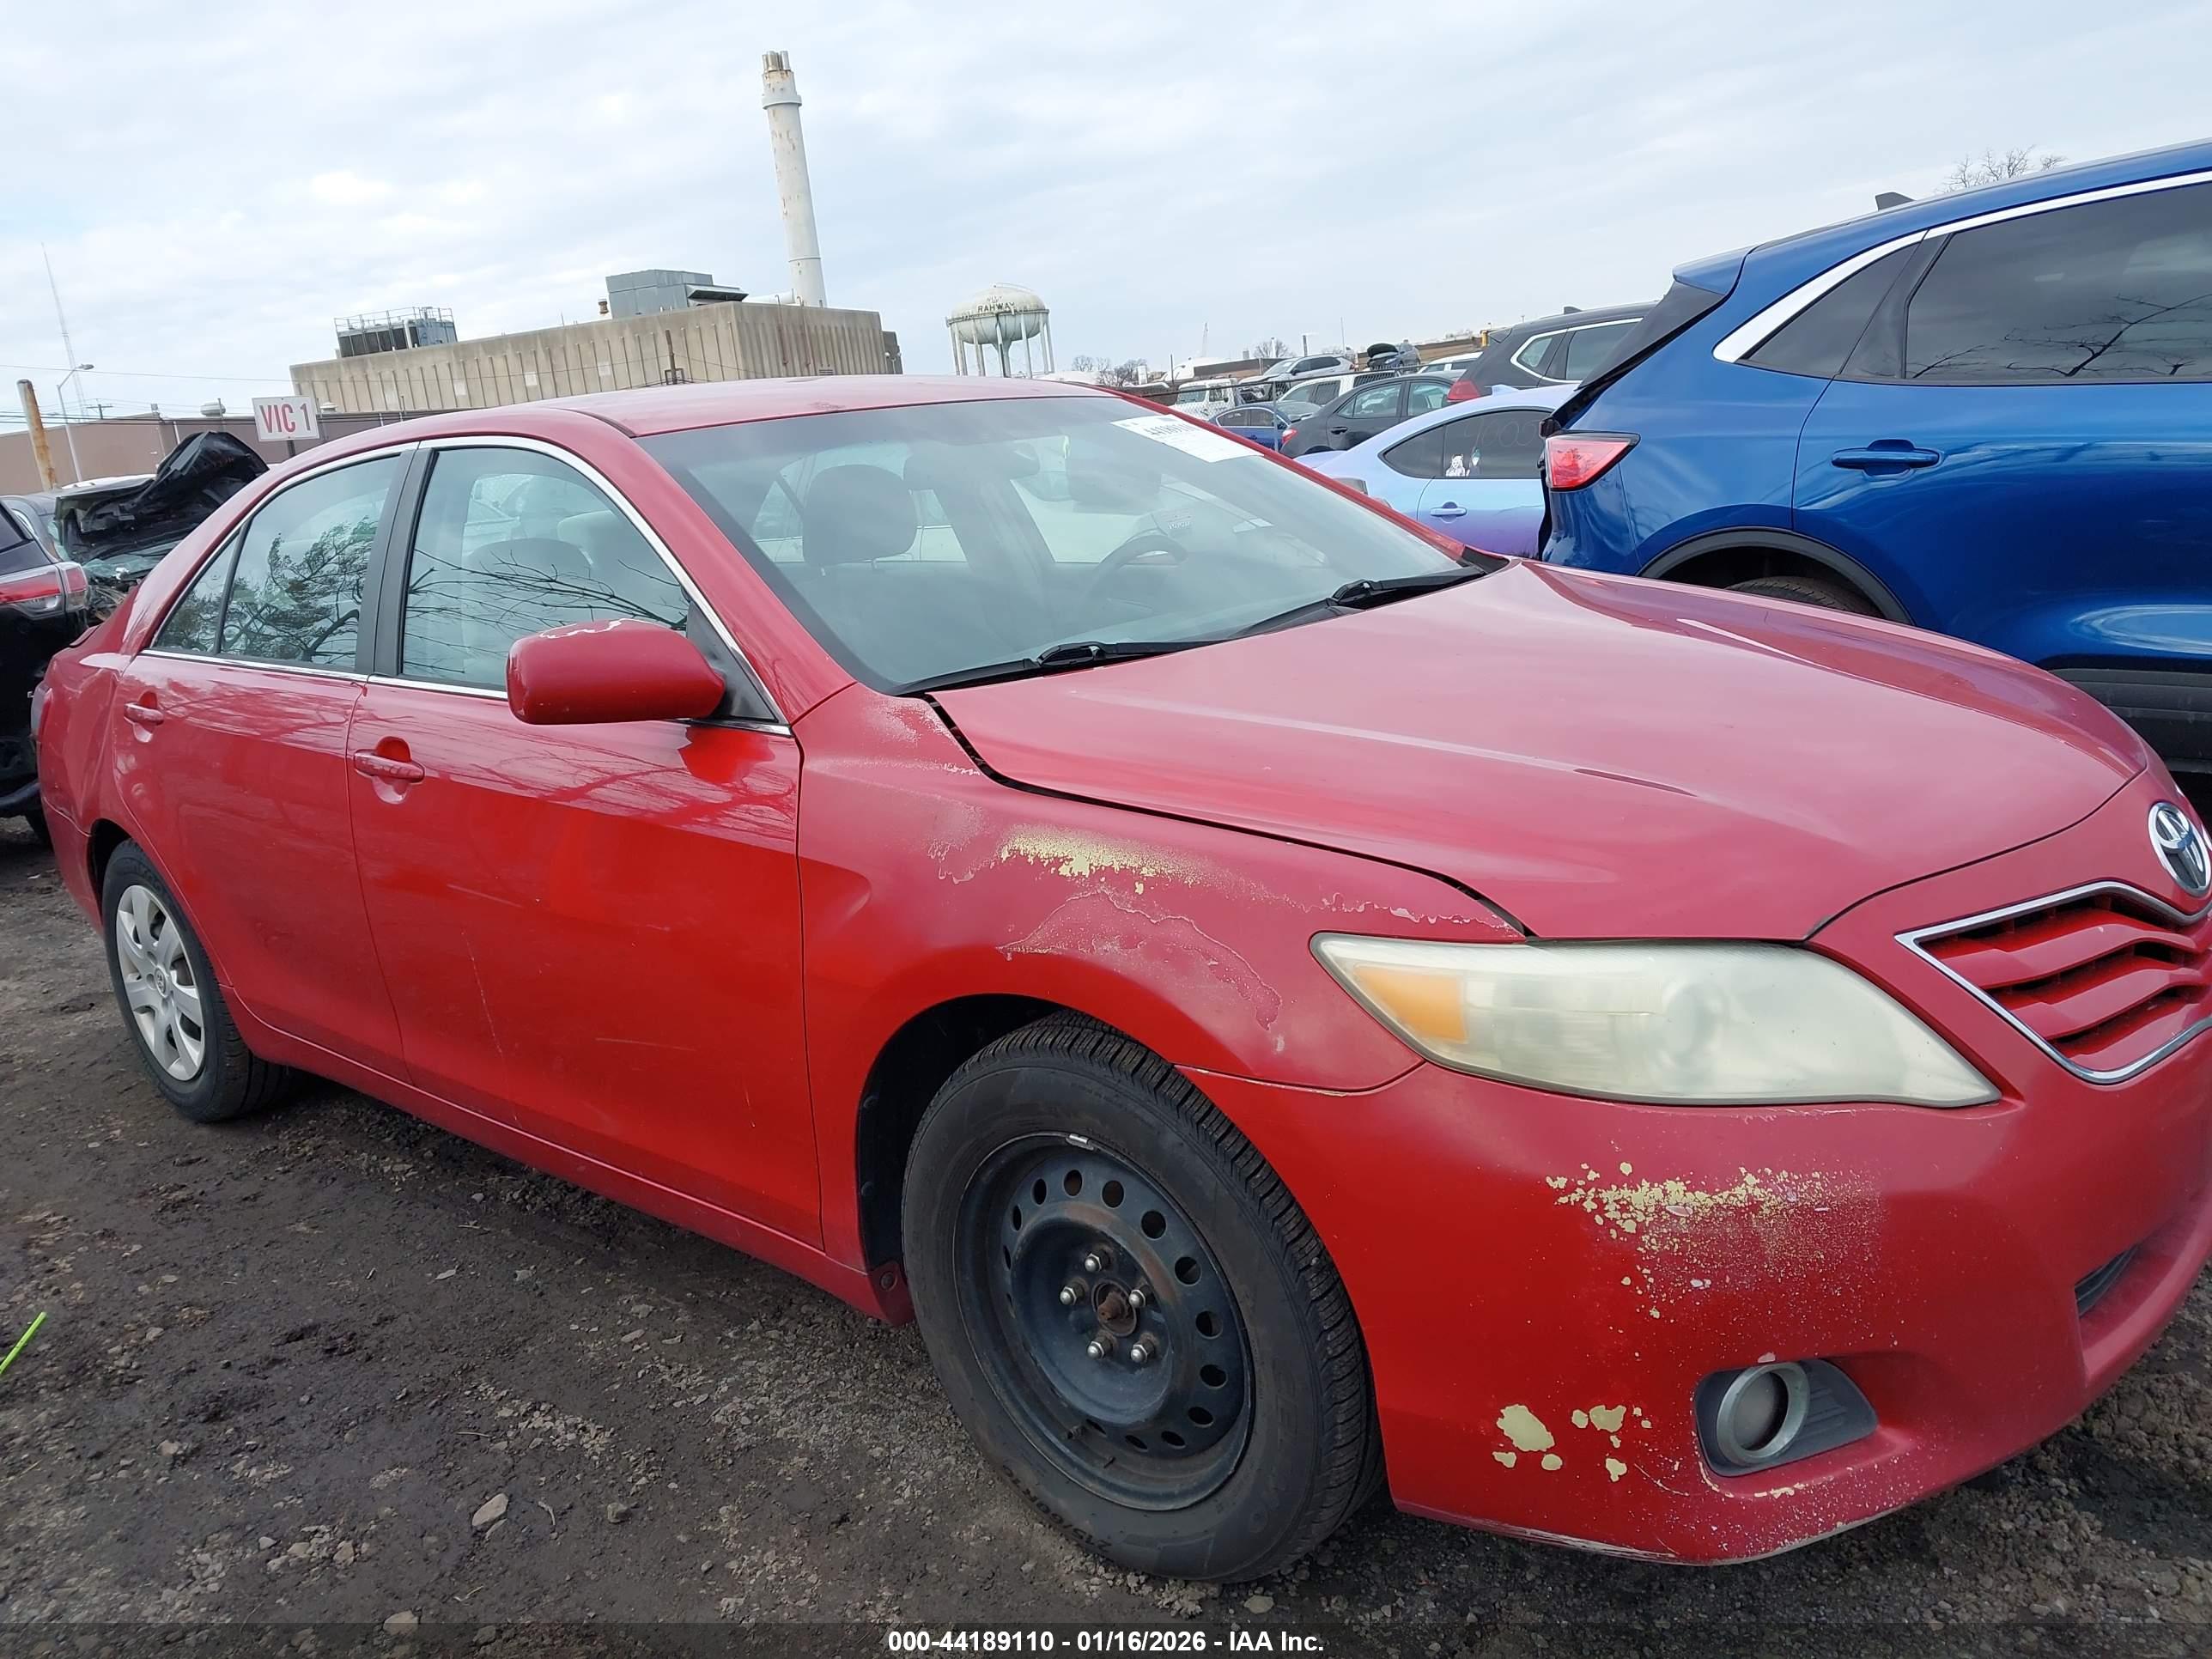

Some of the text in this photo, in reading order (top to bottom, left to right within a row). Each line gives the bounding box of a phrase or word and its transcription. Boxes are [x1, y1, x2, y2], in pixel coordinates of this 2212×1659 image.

[977, 301, 1016, 313] RAHWAY
[258, 403, 311, 434] VIC 1
[1000, 1462, 1113, 1553] 215/60R16
